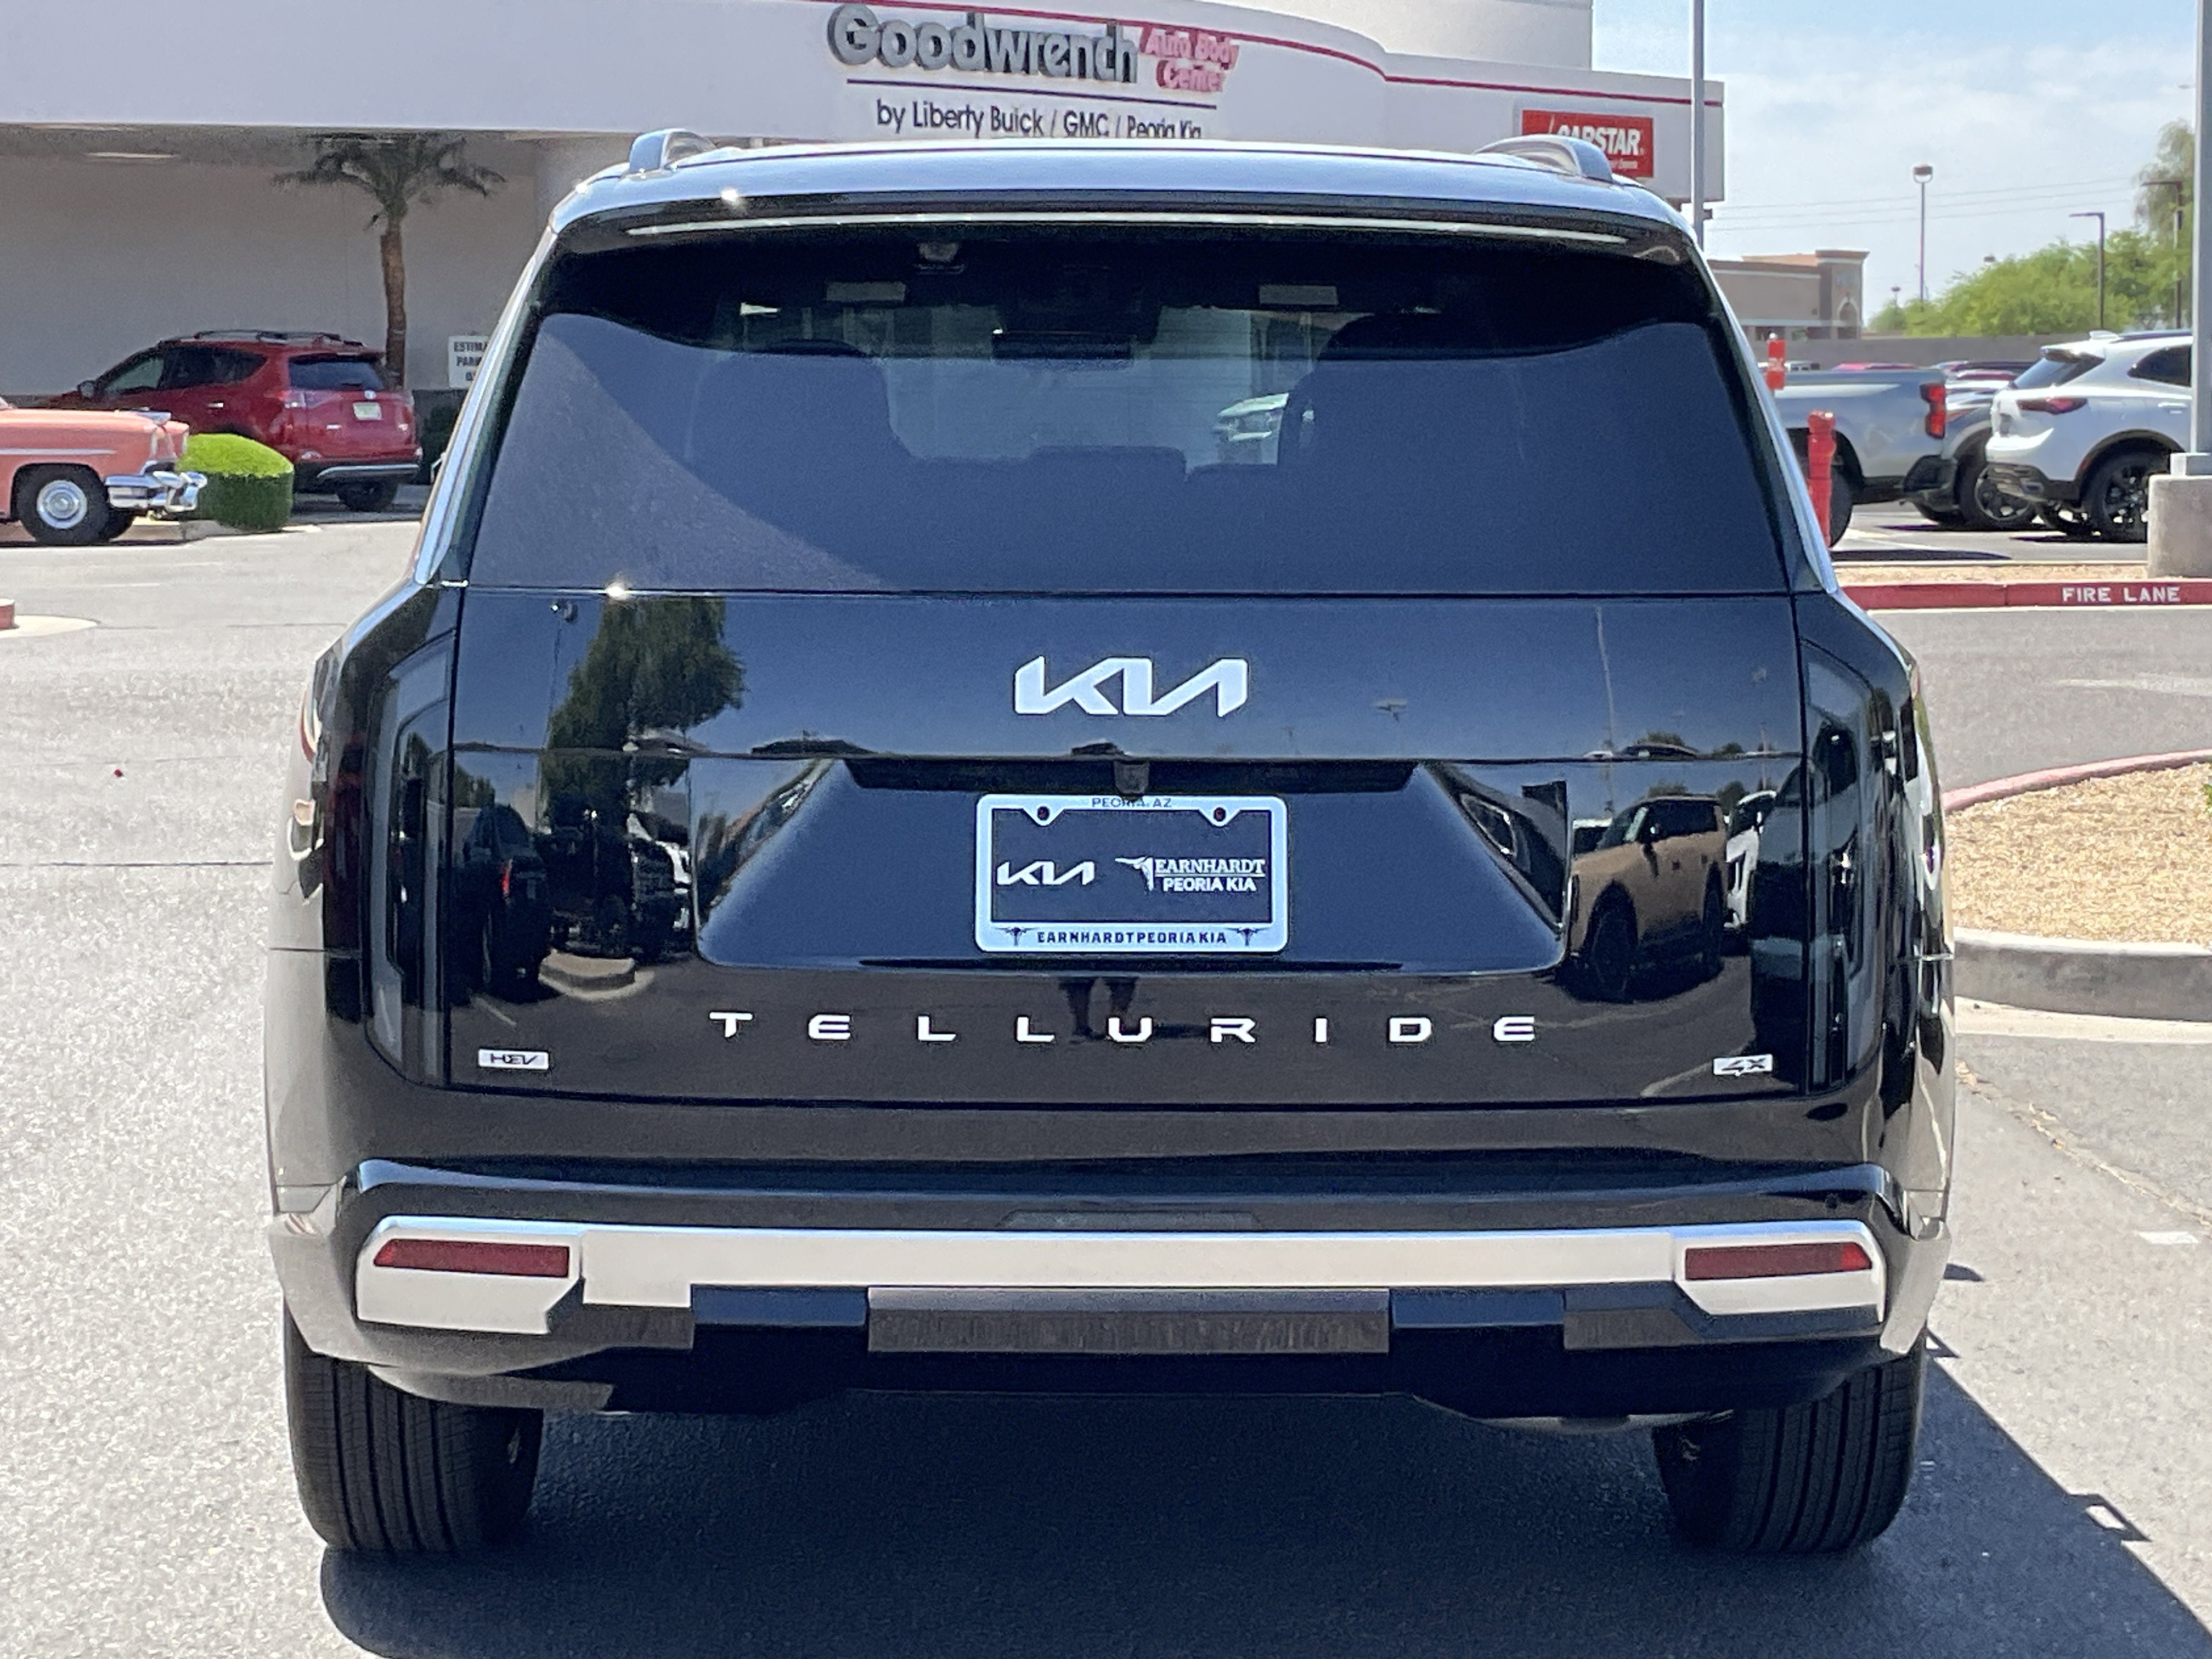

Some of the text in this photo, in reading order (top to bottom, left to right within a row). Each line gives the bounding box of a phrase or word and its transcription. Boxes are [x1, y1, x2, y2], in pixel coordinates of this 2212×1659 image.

[827, 4, 1138, 83] Goodwrench
[1140, 27, 1239, 70] Auto Body
[1156, 60, 1226, 92] Center
[877, 99, 906, 134] by
[912, 101, 985, 139] Liberty
[990, 105, 1044, 137] Buick
[1064, 110, 1109, 137] GMC
[2062, 586, 2181, 602] FIRE LANE
[1015, 656, 1248, 717] KIA
[1153, 797, 1172, 808] AZ
[996, 860, 1096, 885] KIA
[1155, 859, 1266, 873] EARNHARDT
[1163, 878, 1256, 891] PEORIA KIA
[709, 1011, 1536, 1043] TELLURIDE
[490, 1052, 539, 1065] HEV
